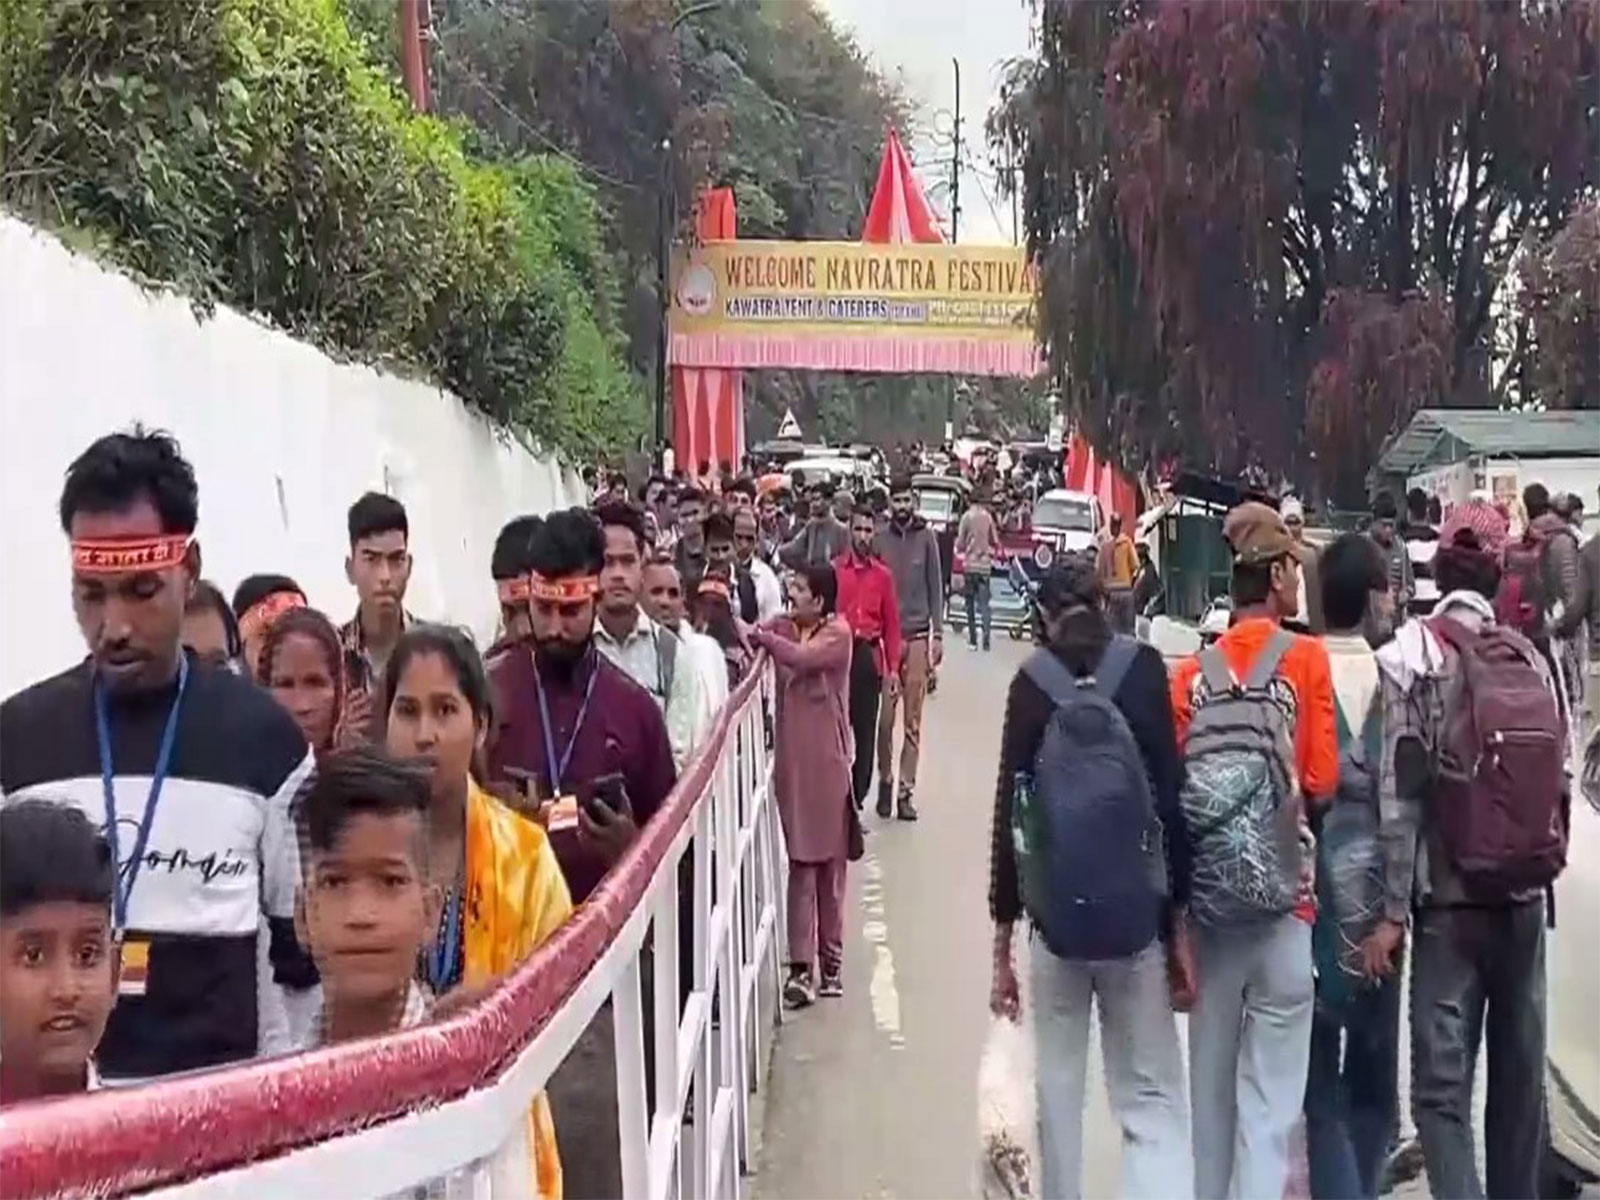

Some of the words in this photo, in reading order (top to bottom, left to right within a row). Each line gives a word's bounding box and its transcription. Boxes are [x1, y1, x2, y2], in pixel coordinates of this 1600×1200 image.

[725, 256, 816, 290] WELCOME
[826, 257, 937, 292] NAVRATRA
[947, 260, 1033, 293] FESTIVA
[725, 298, 783, 318] KAWATRA
